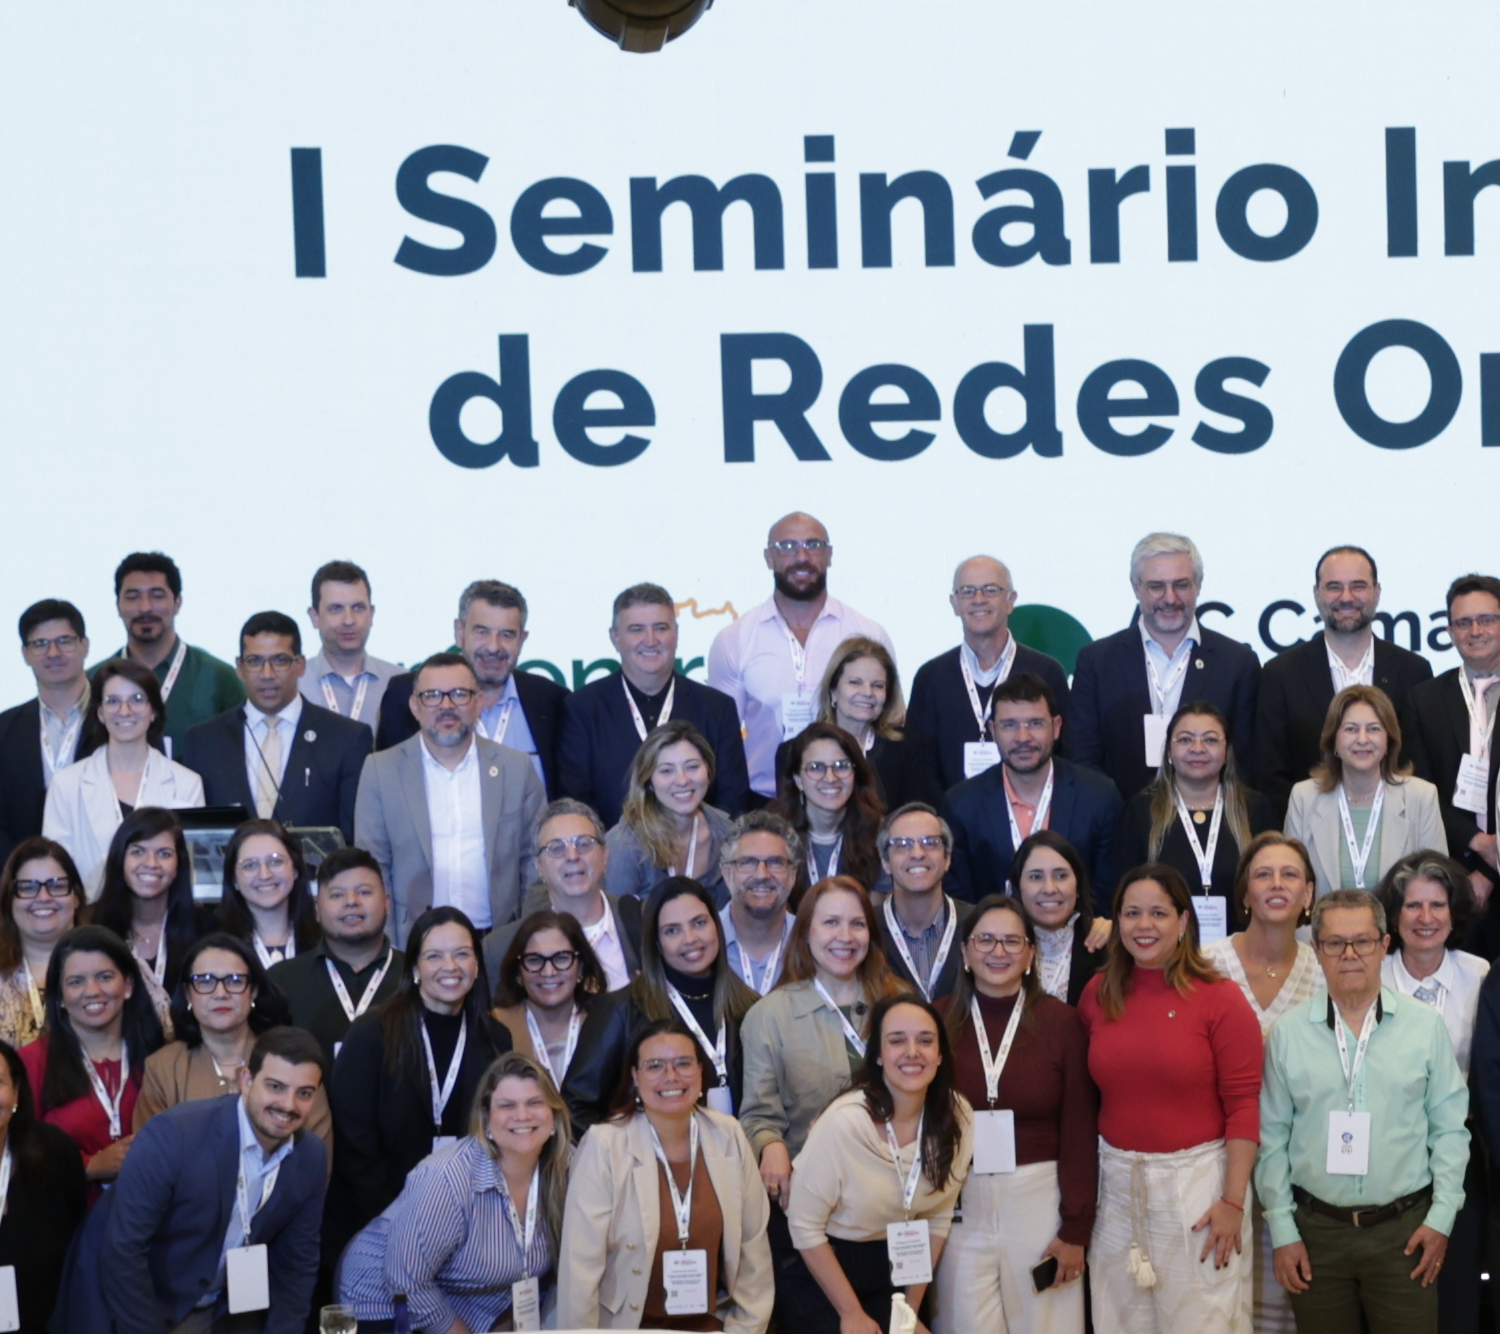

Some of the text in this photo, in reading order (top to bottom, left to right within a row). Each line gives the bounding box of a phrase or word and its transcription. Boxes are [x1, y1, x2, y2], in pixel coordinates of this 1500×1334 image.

[290, 147, 327, 279] I
[393, 127, 1319, 277] Seminário
[428, 333, 656, 470] de
[720, 323, 1274, 463] Redes
